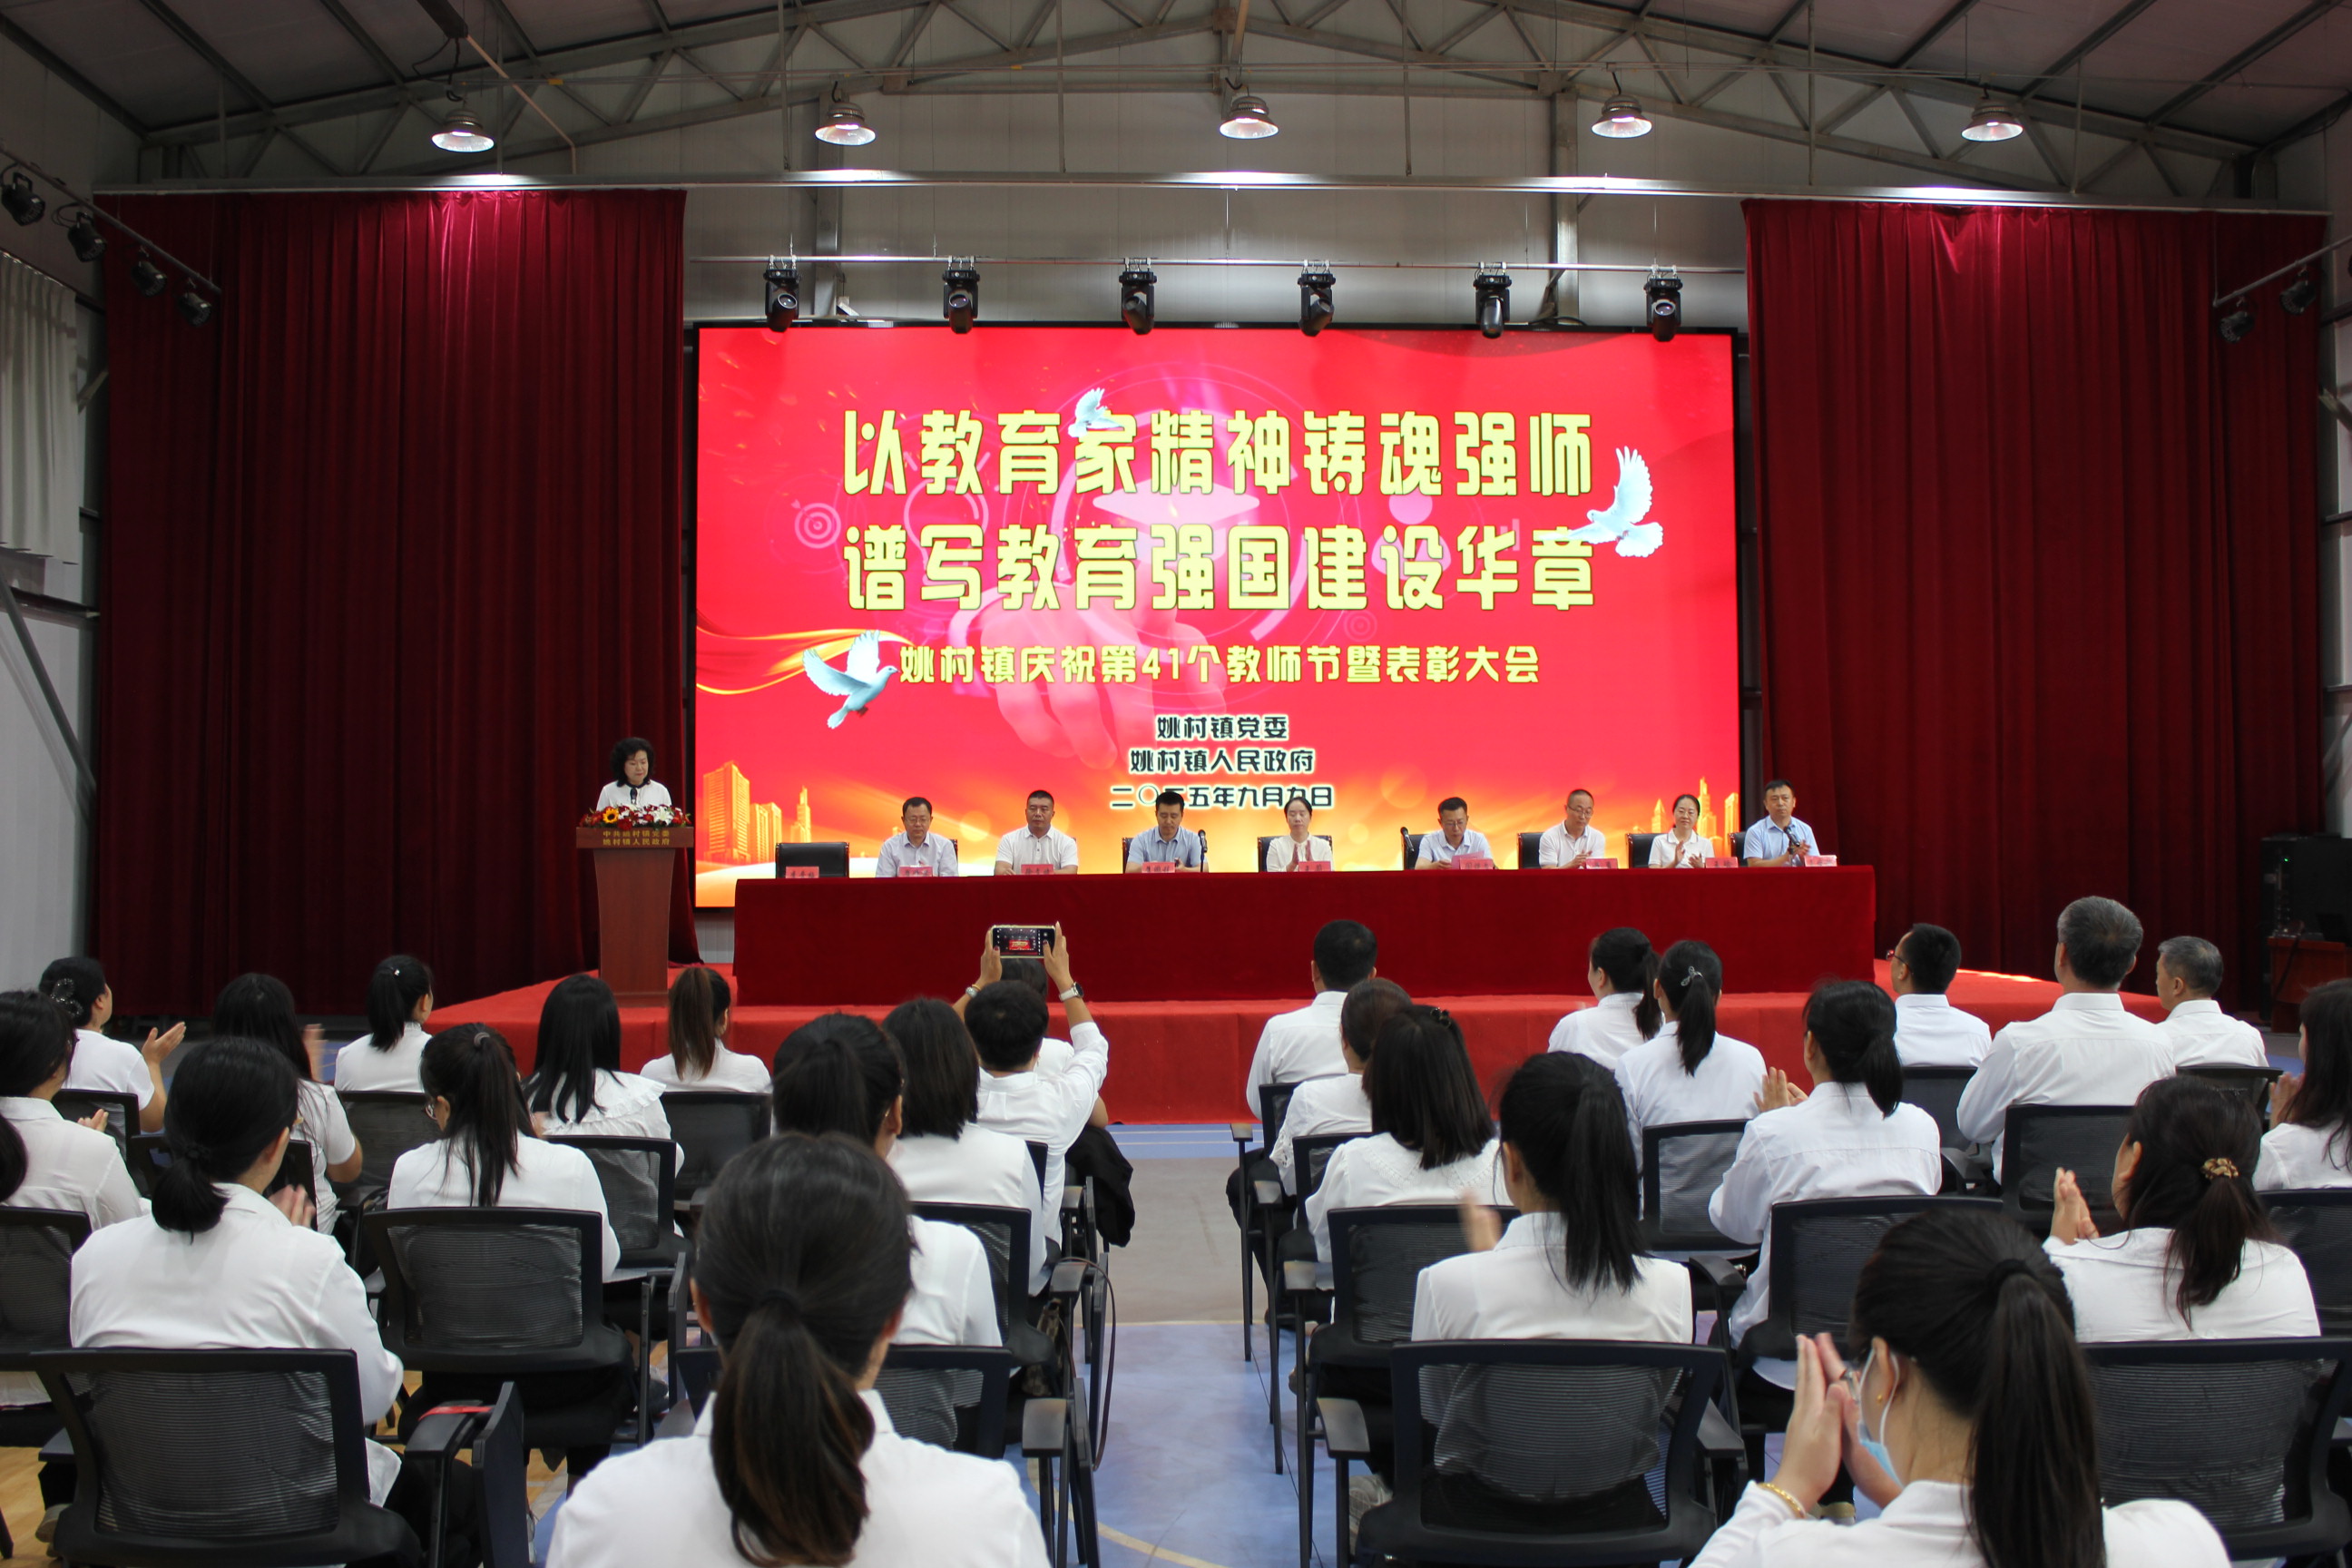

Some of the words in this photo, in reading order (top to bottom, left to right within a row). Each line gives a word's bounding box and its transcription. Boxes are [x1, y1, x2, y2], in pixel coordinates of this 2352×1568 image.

[843, 409, 1592, 496] 以教育家精神铸魂强师
[843, 524, 1594, 611] 谱写教育强国建设华章
[899, 645, 1539, 683] 姚村镇庆祝第41个教师节暨表彰大会
[1156, 715, 1289, 740] 姚村镇党委
[1129, 749, 1314, 773] 姚村镇人民政府
[603, 838, 670, 846] 姚村镇人民政府
